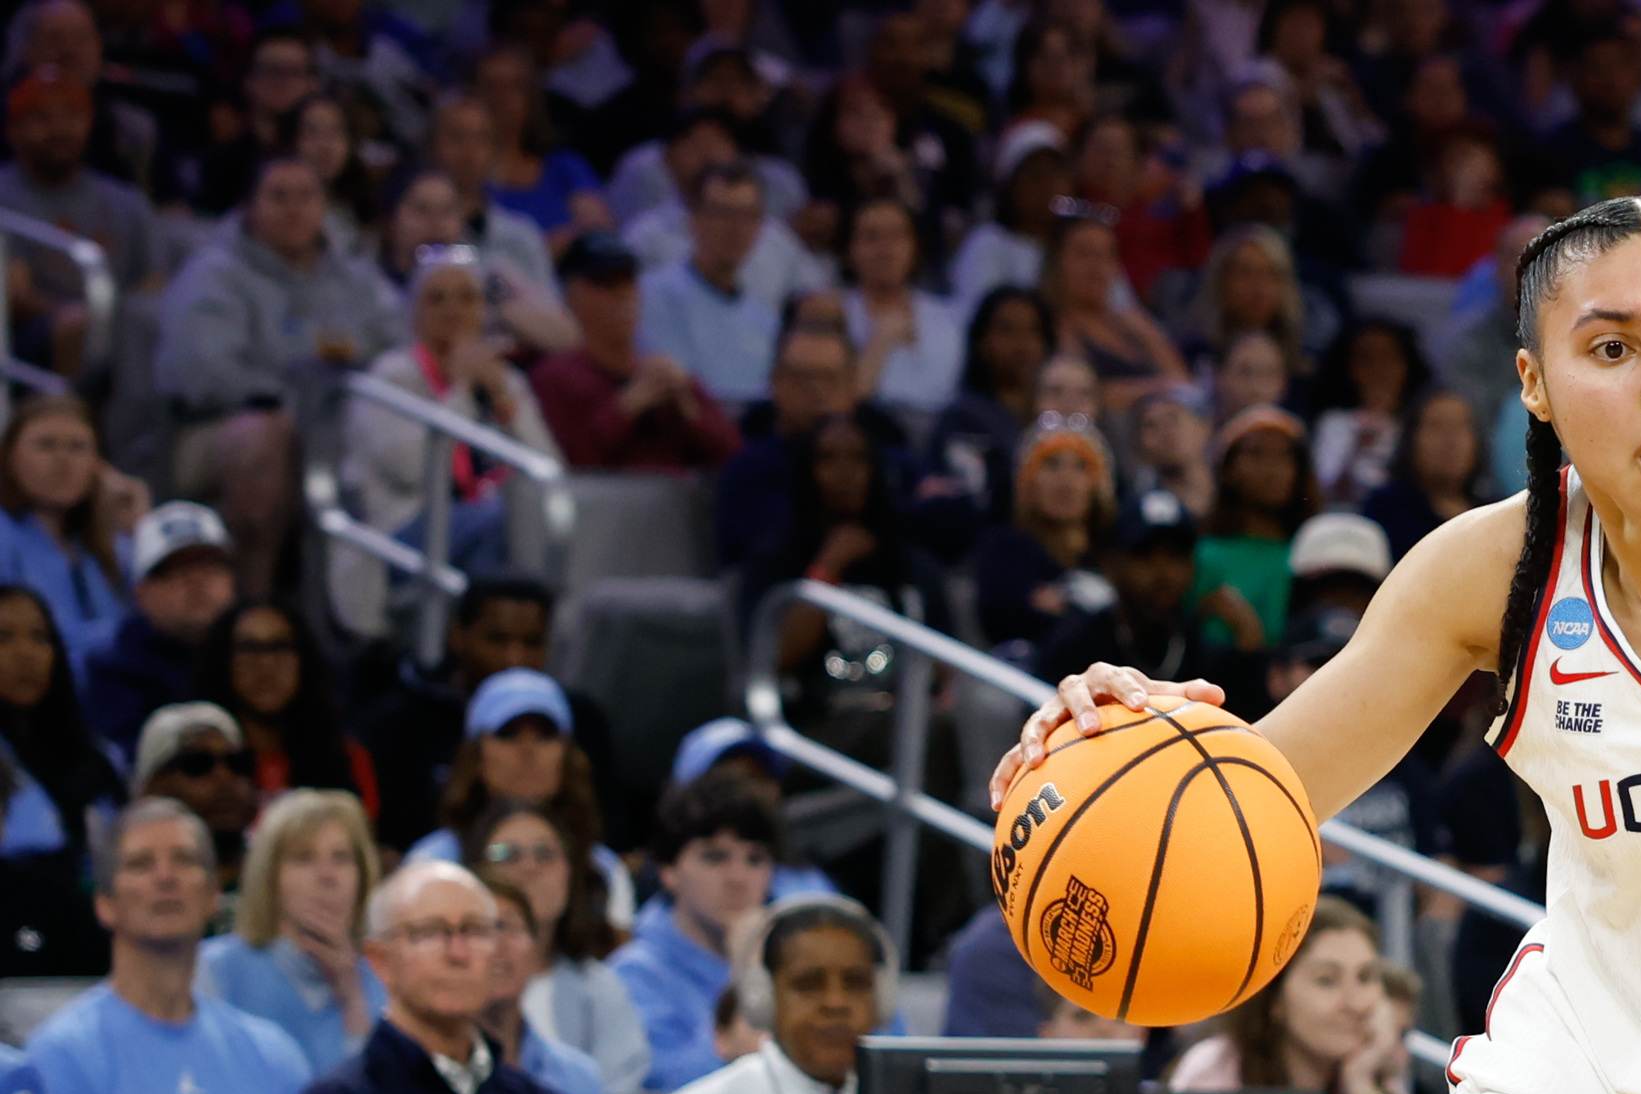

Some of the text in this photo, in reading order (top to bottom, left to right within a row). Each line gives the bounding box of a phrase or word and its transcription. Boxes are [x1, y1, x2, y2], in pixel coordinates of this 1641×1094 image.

[1553, 621, 1590, 636] NCAA
[1556, 700, 1603, 718] BE THE
[1555, 715, 1604, 733] CHANGE
[1012, 862, 1024, 890] NXT
[1053, 906, 1079, 963] MARCH
[1069, 889, 1105, 967] MADNESS
